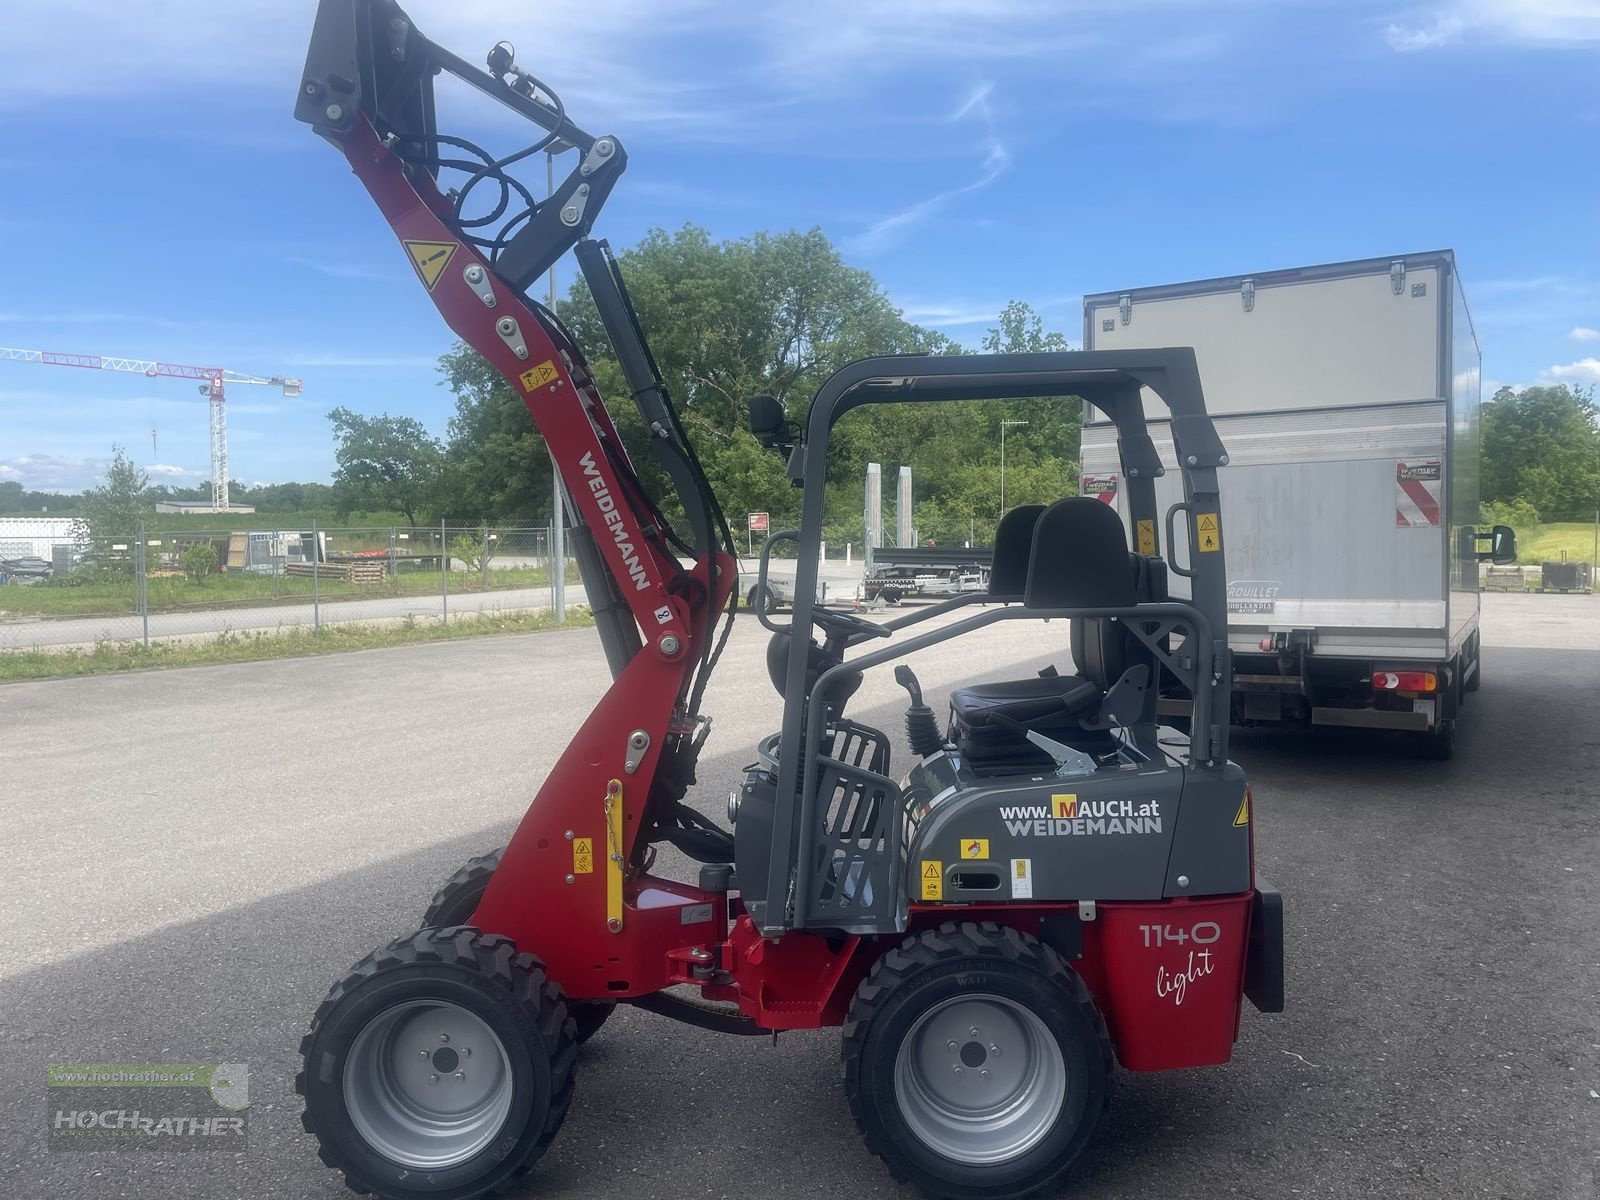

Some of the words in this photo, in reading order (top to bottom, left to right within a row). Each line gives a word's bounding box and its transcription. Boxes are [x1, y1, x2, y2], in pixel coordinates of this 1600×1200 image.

[579, 451, 651, 591] WEIDEMANN
[1226, 587, 1280, 597] ROUILLET
[1000, 800, 1160, 819] www.MAUCH.at
[1005, 817, 1162, 837] WEIDEMANN
[1139, 922, 1221, 947] 1140
[1157, 948, 1215, 1006] light
